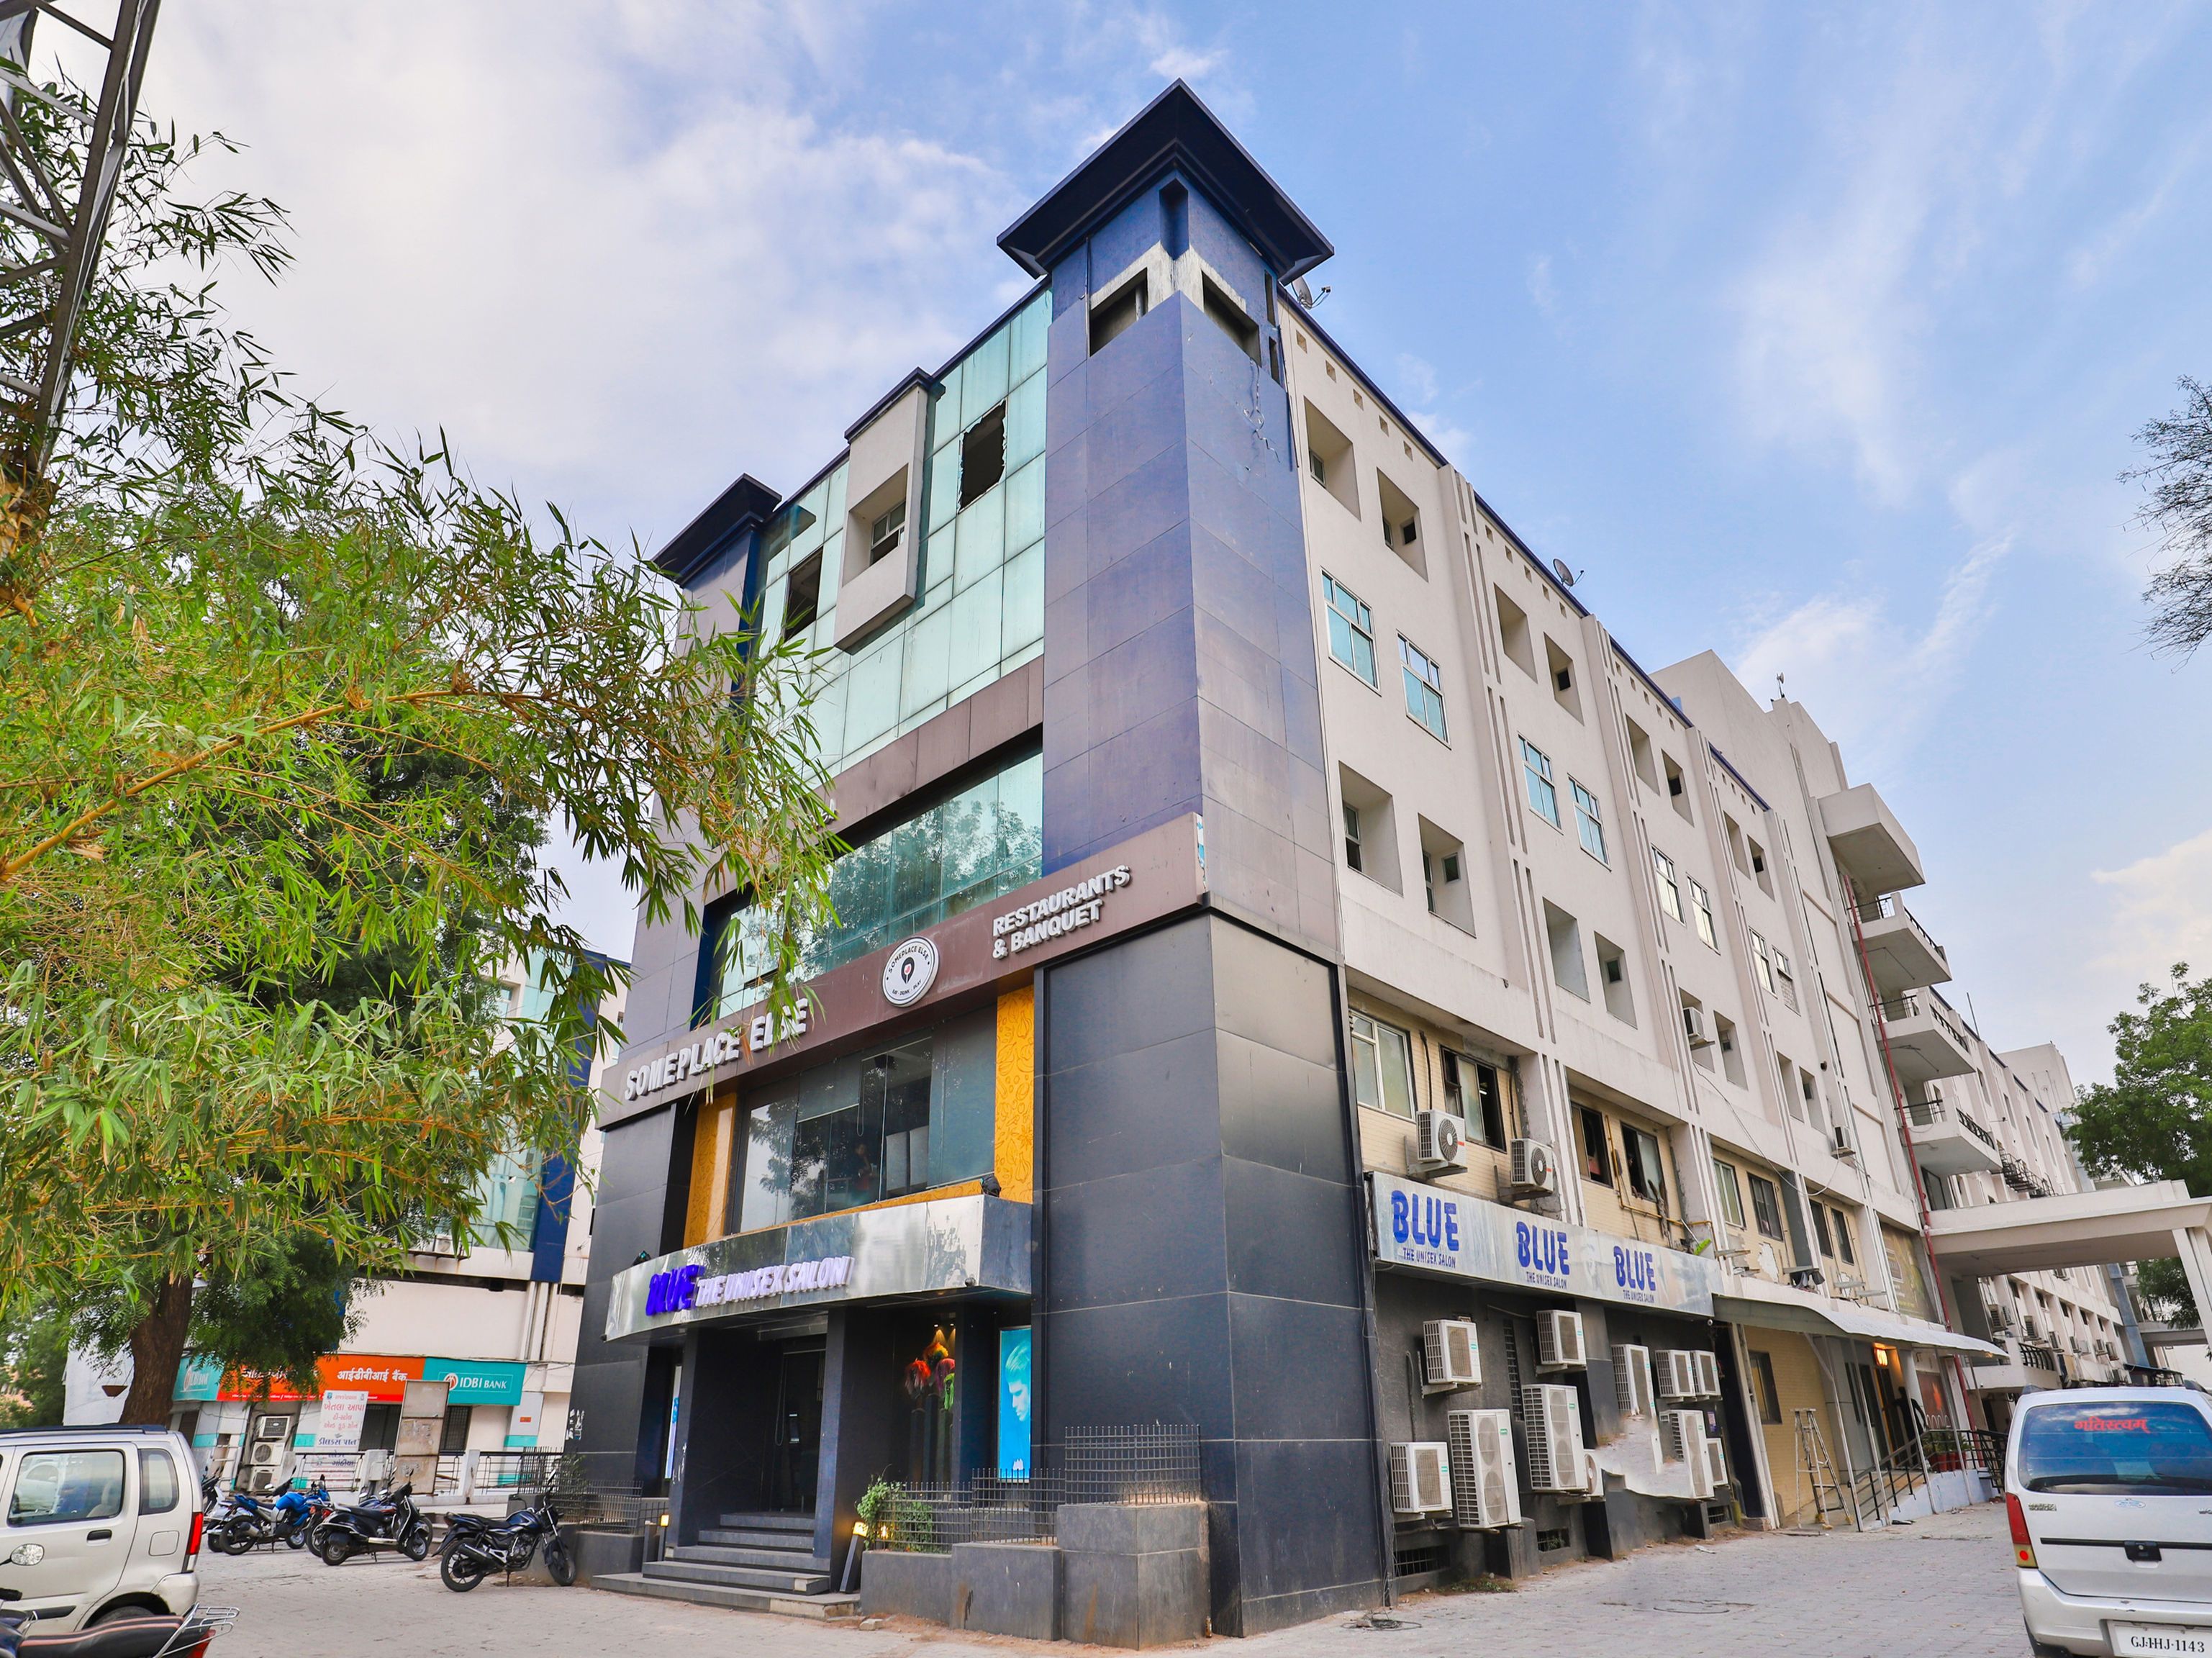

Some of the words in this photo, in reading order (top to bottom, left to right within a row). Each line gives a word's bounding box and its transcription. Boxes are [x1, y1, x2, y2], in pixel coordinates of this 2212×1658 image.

[992, 864, 1130, 937] RESTAURANTS
[992, 938, 1007, 959] &
[1010, 899, 1103, 953] BANQUET
[889, 946, 917, 973] SOMEPLACE
[918, 946, 929, 961] ELSE
[625, 1025, 741, 1101] SOMEPLACE
[1391, 1190, 1459, 1251] BLUE
[1402, 1247, 1415, 1261] THE
[1416, 1250, 1437, 1264] UNISEX
[1438, 1254, 1456, 1268] SALON
[1516, 1221, 1569, 1275] BLUE
[1613, 1246, 1655, 1291] BLUE
[695, 1276, 727, 1307] THE
[724, 1264, 789, 1303] UNISEX
[784, 1256, 855, 1293] SALON
[1526, 1272, 1535, 1283] THE
[1536, 1274, 1552, 1286] UNISEX
[1554, 1277, 1567, 1290] SALON
[392, 1369, 408, 1381] बैंक
[460, 1377, 483, 1388] IDBI
[484, 1380, 507, 1389] BANK
